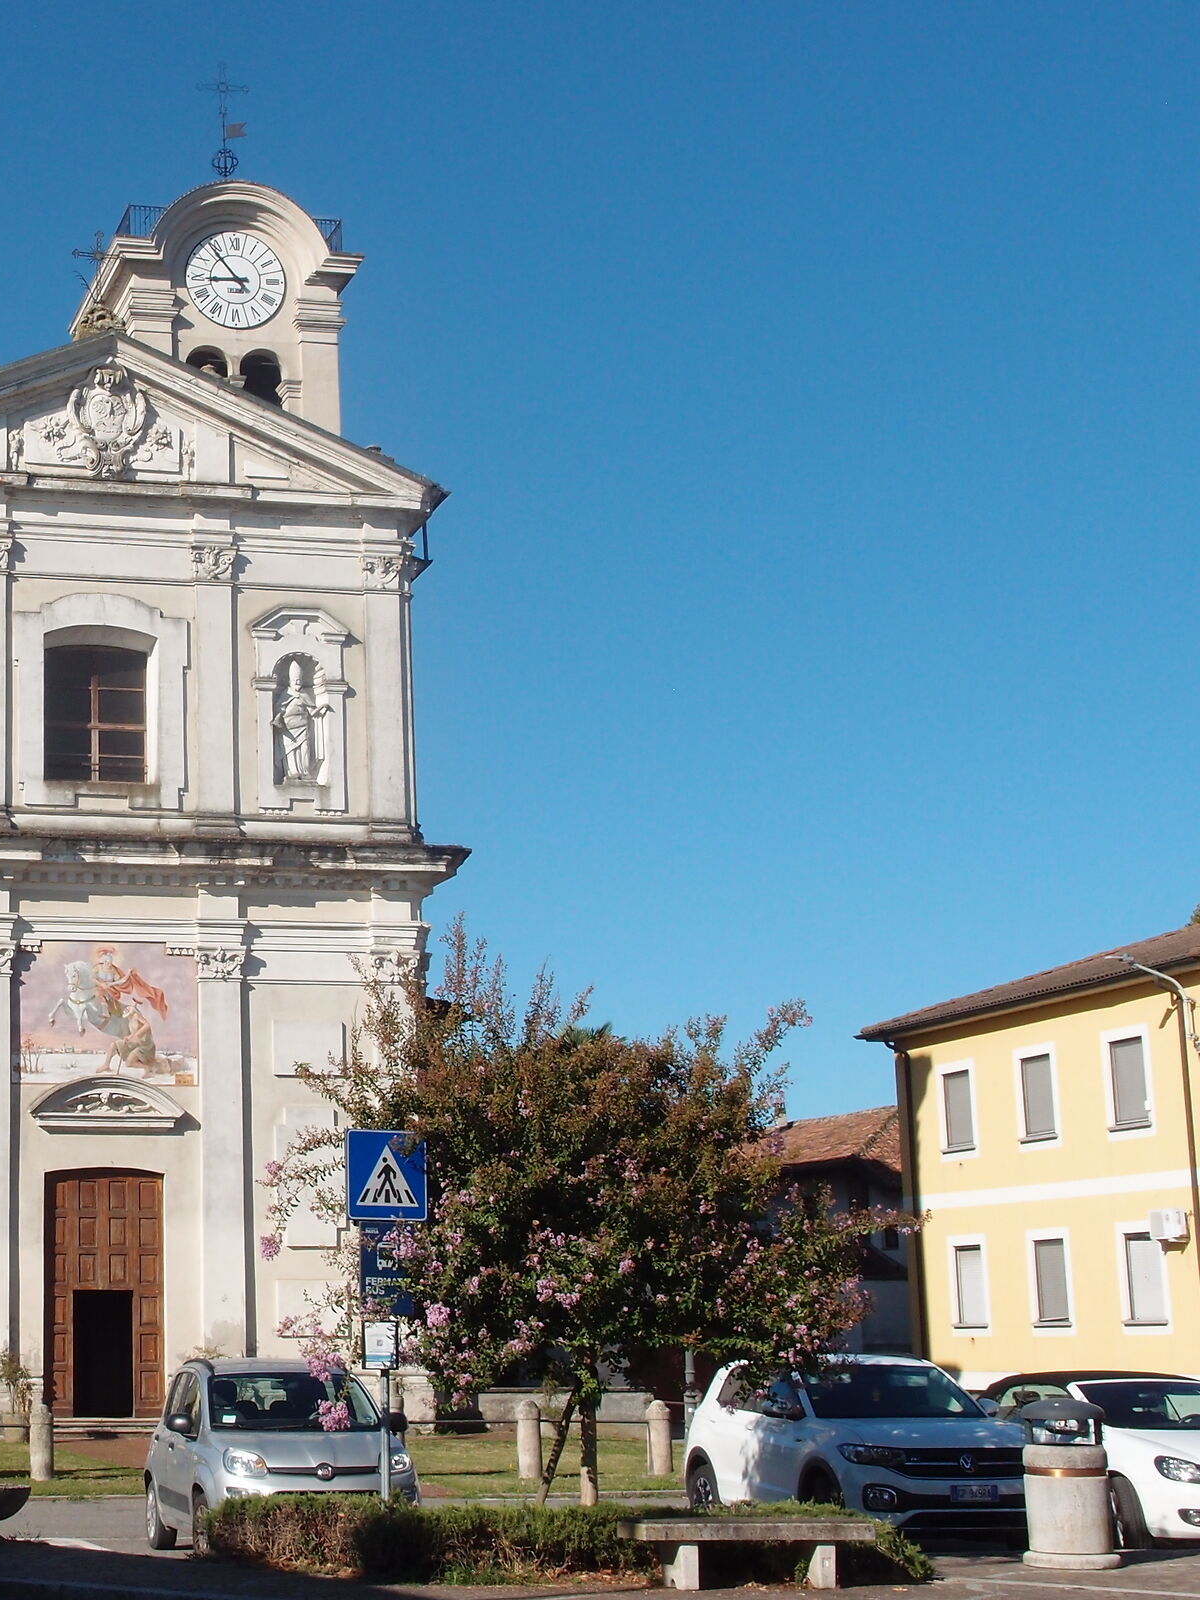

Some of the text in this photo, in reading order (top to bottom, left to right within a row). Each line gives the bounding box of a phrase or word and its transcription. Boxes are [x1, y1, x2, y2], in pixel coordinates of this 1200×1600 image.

[229, 237, 240, 250] XII
[196, 254, 210, 265] X
[261, 259, 273, 268] II
[209, 302, 223, 317] VII
[232, 308, 241, 322] VI
[250, 306, 260, 319] V
